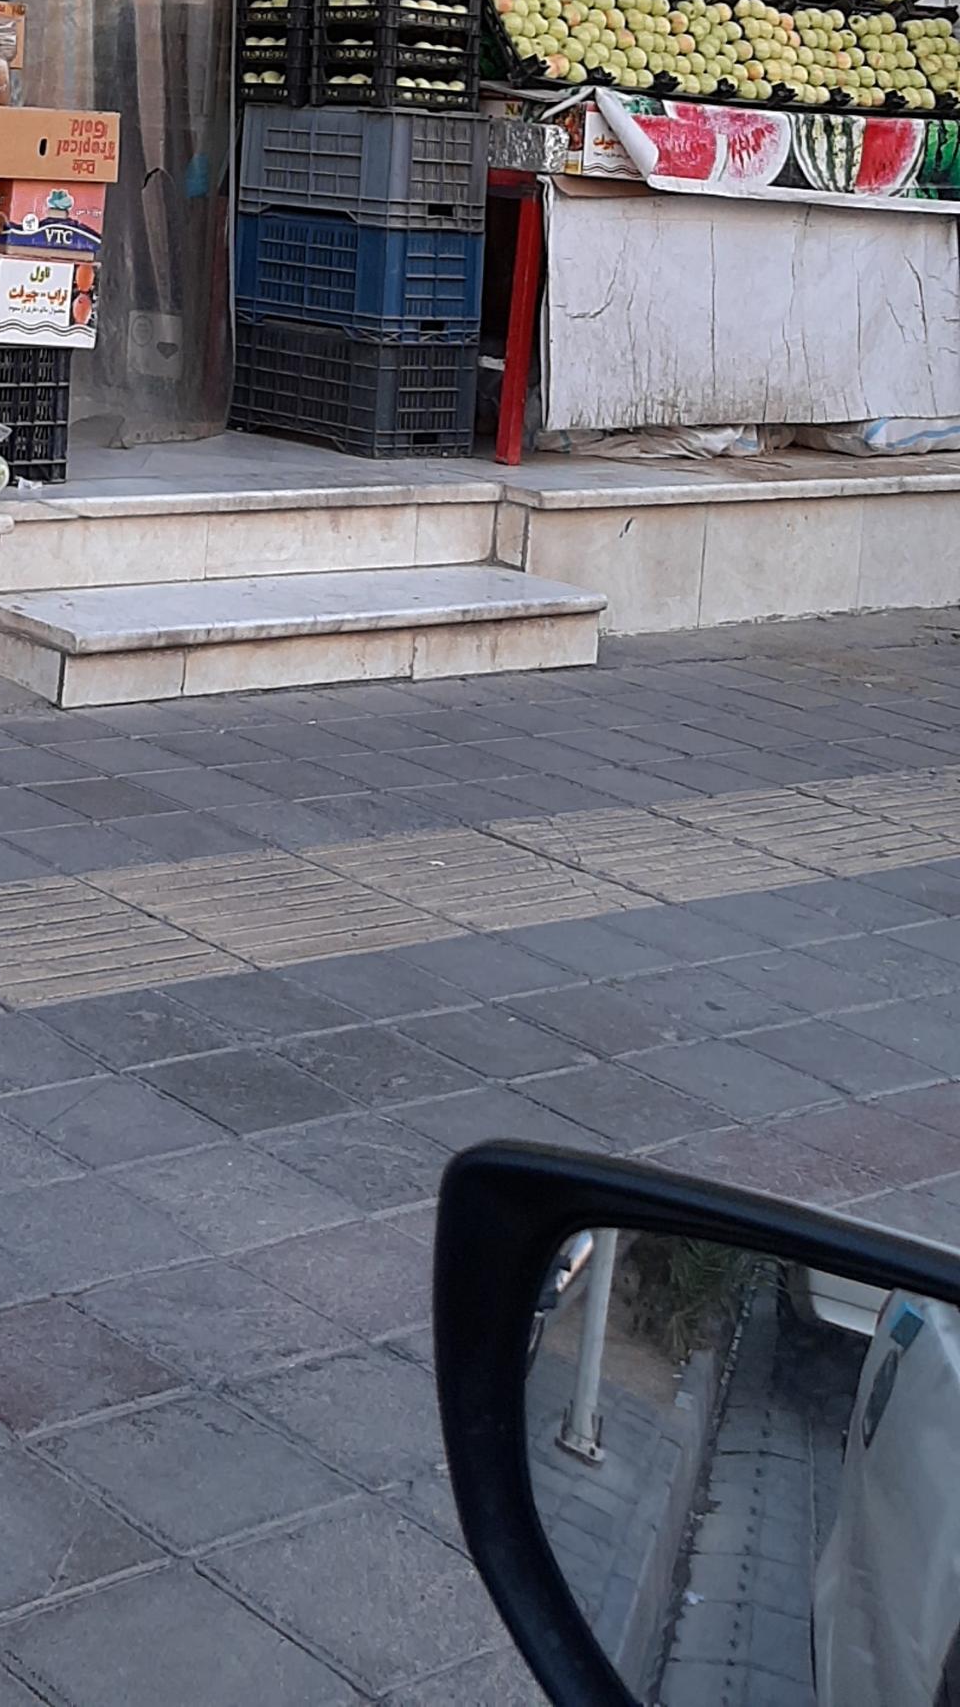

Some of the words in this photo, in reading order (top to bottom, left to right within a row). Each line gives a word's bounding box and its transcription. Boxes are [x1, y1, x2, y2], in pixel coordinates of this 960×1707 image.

[68, 118, 108, 139] Gold
[55, 137, 116, 161] Tropical
[72, 159, 96, 174] Dole
[45, 228, 74, 245] VTC
